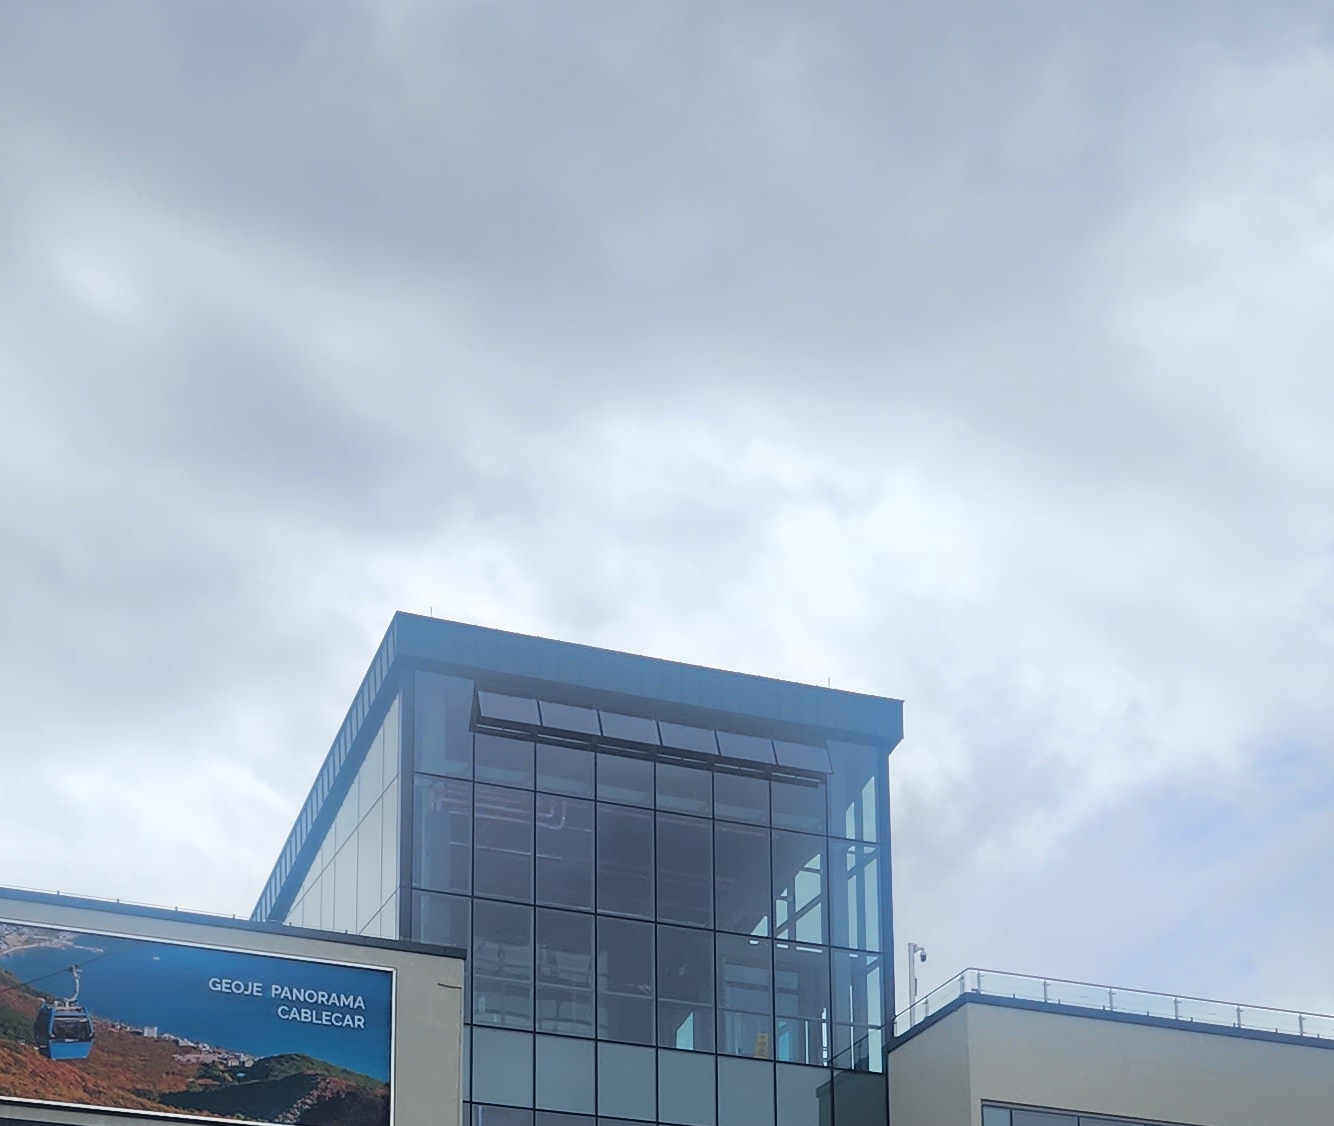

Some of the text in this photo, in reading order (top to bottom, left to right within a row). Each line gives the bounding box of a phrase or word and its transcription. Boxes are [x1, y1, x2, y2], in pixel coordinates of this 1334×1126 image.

[208, 977, 366, 1011] GEOJE PANORAMA
[277, 1005, 366, 1030] CABLECAR
